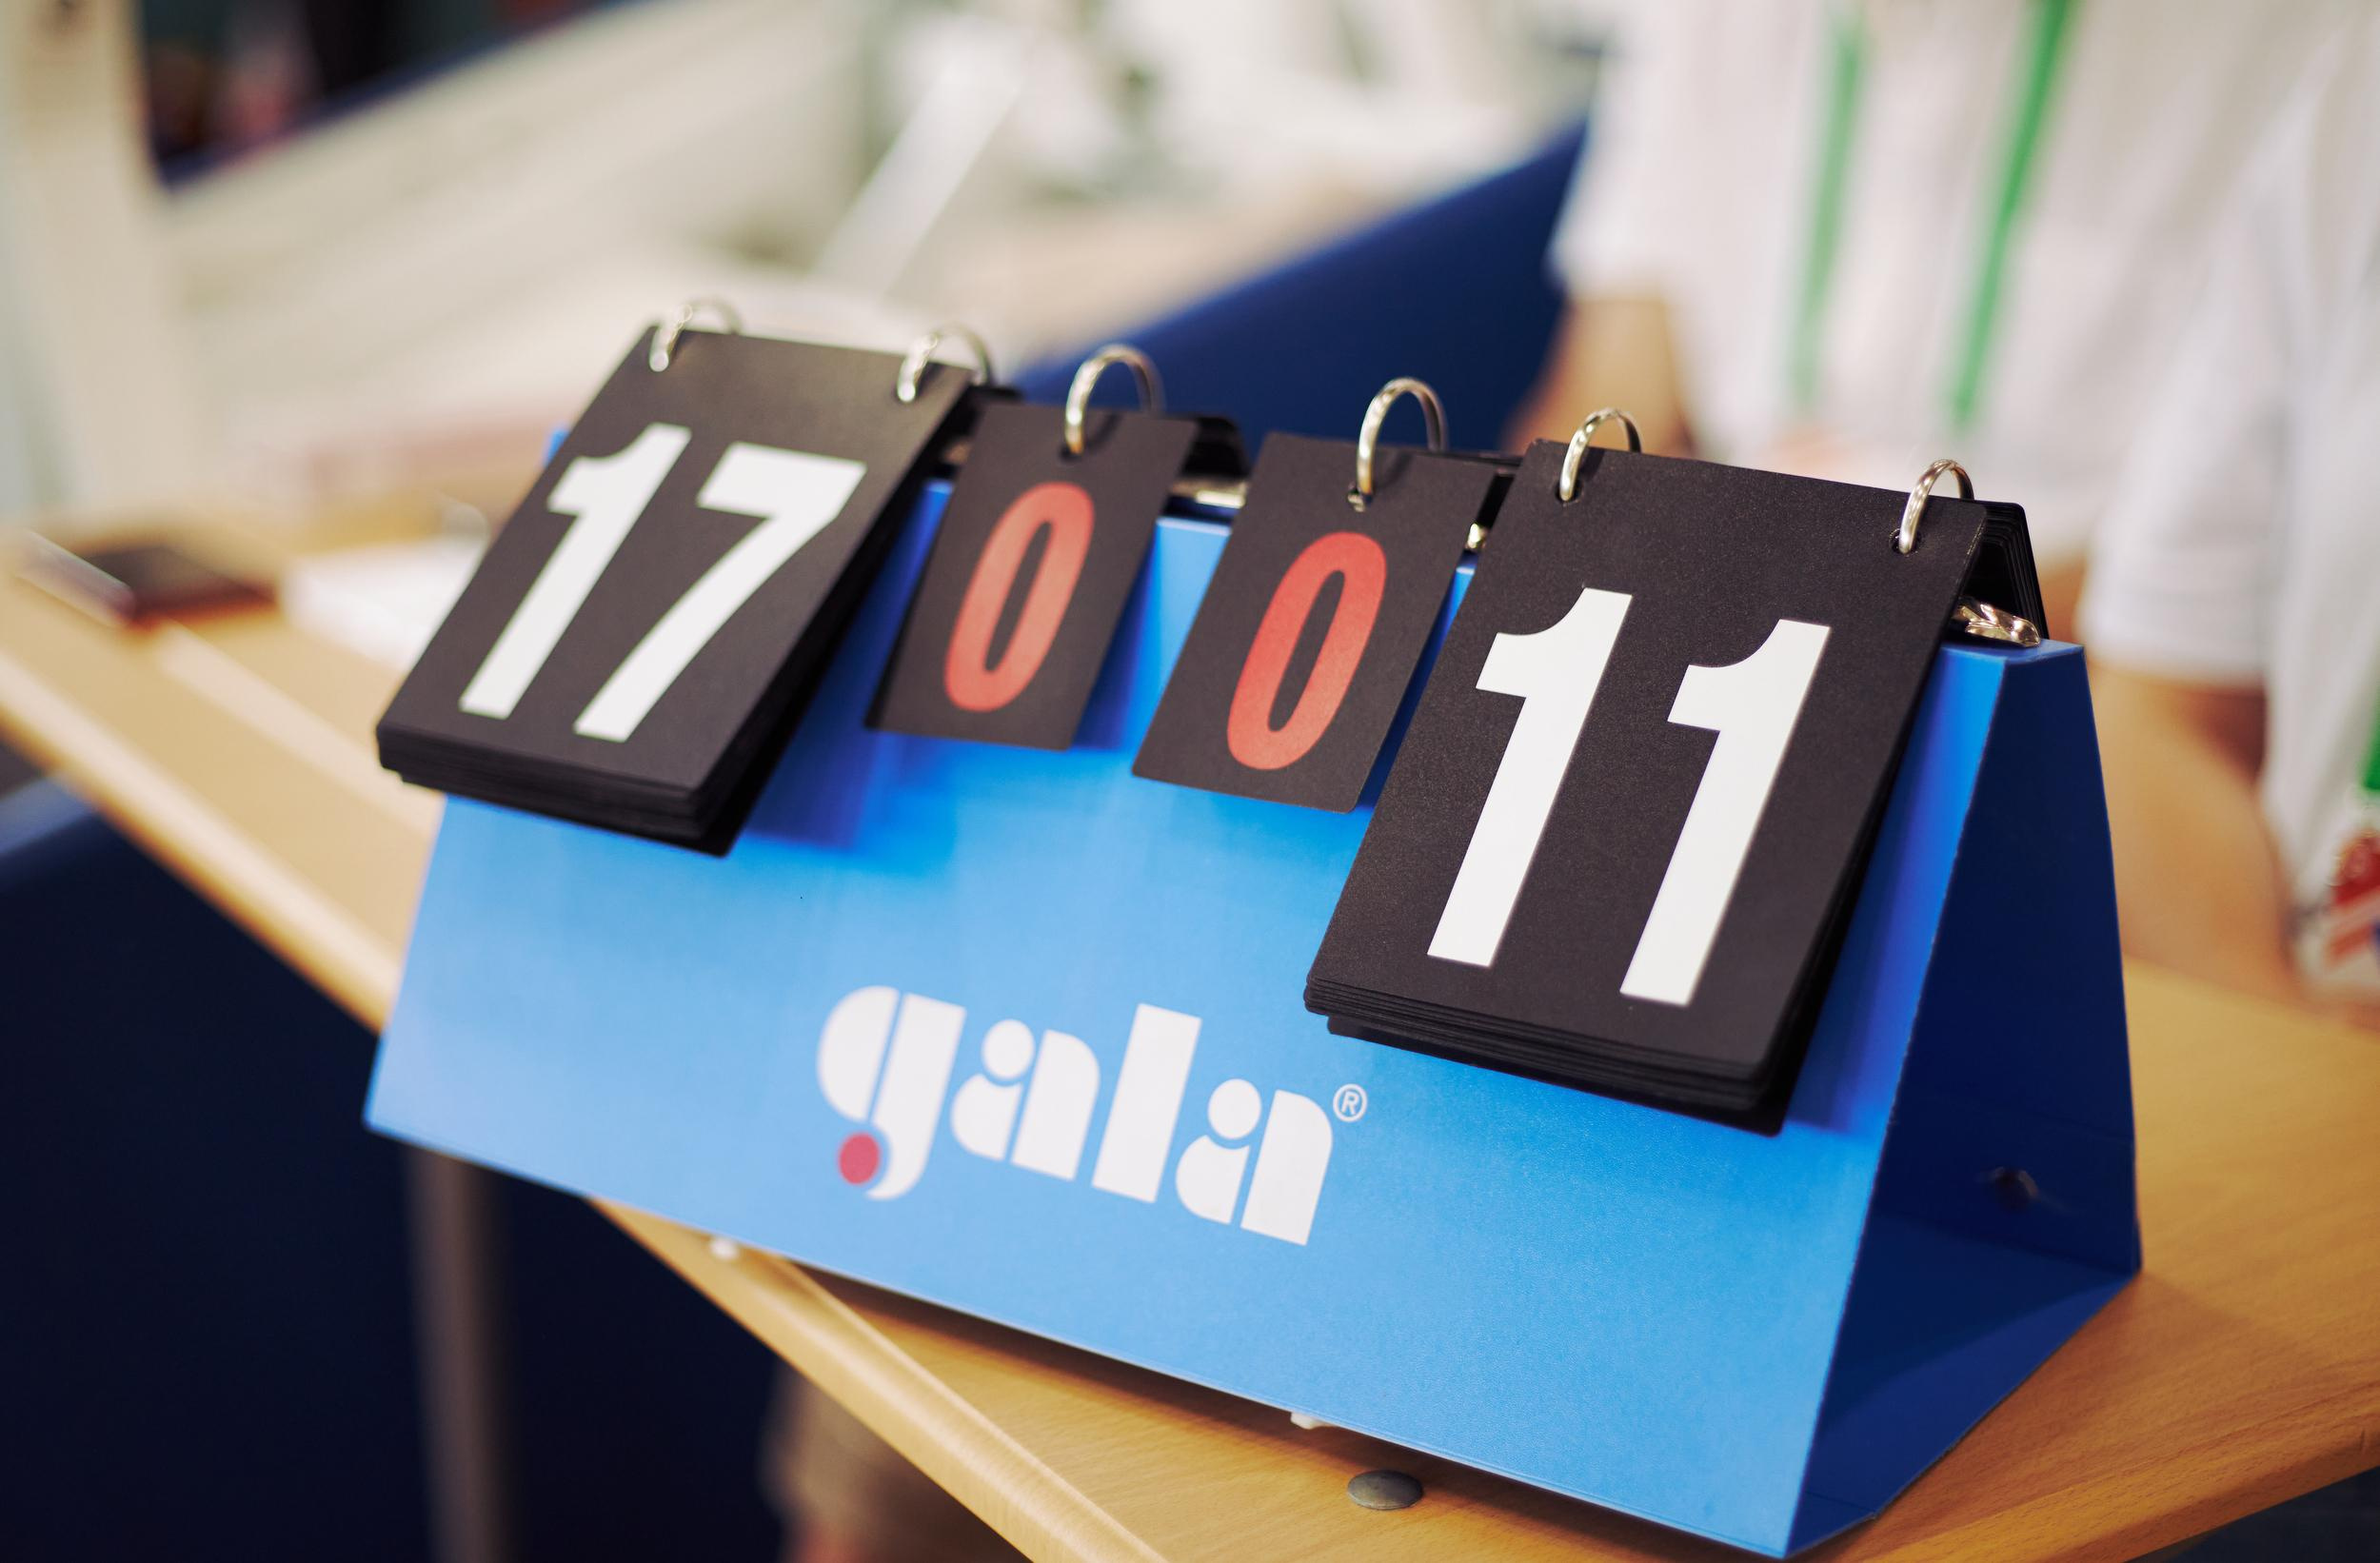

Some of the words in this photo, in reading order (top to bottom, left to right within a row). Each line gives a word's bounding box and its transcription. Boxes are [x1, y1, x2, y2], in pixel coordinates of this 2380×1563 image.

[459, 423, 867, 742] 17
[942, 481, 1096, 714] 0
[1226, 529, 1389, 772] 0
[1426, 586, 1832, 1006] 11
